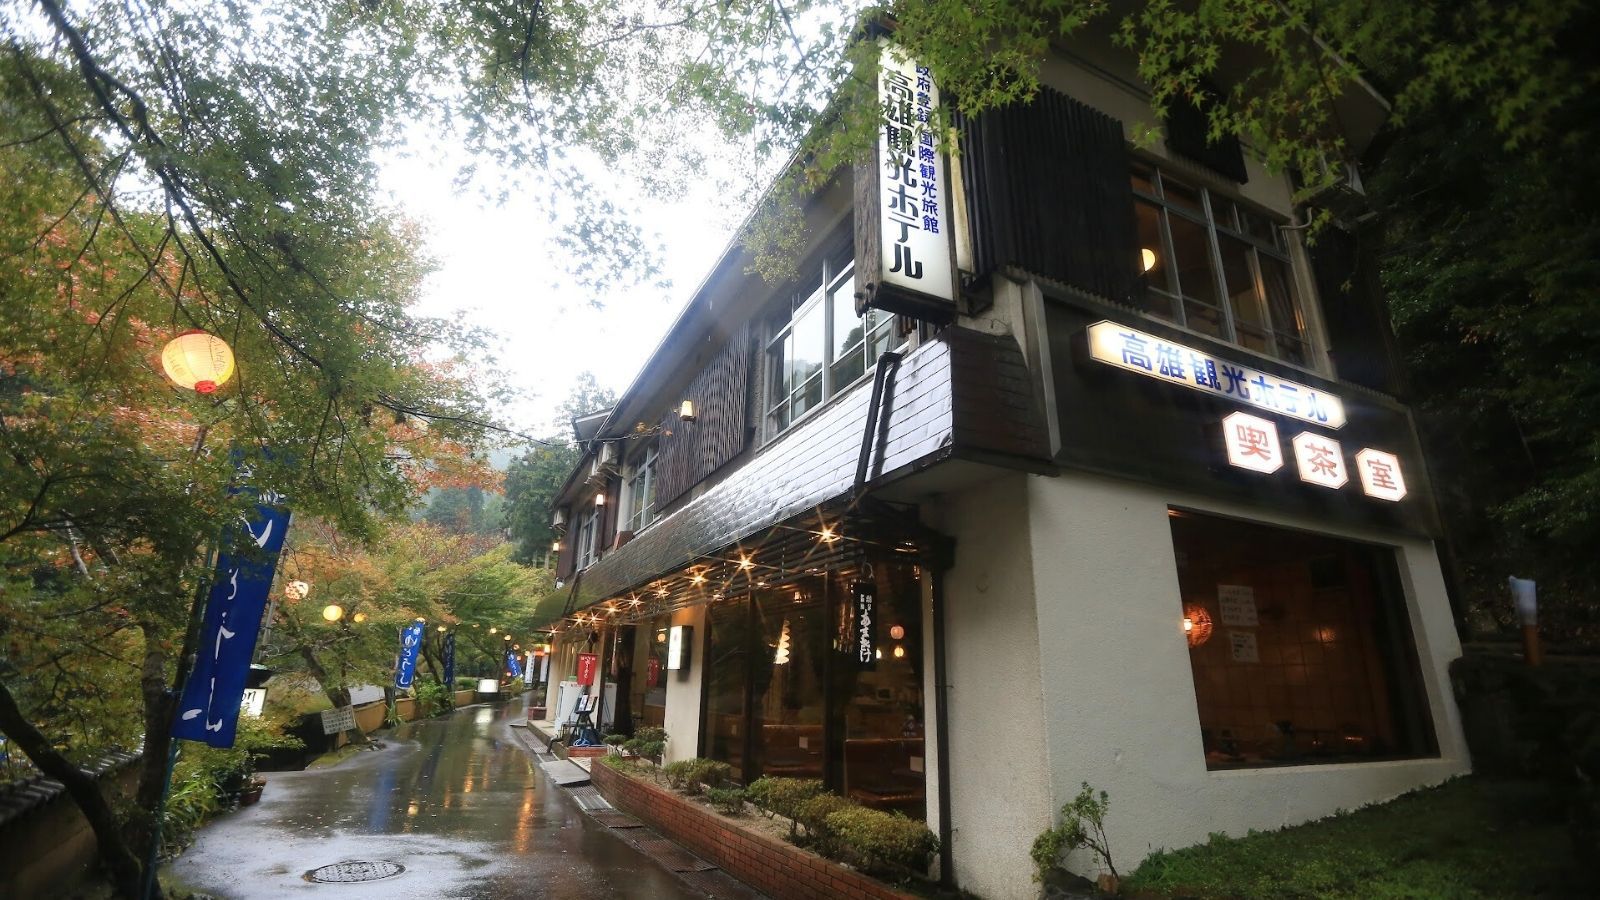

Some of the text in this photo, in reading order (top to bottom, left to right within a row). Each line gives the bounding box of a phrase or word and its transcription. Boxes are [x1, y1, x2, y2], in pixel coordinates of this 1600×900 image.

[1118, 331, 1328, 422] 高雄観光ホテル
[1236, 424, 1398, 491] 喫茶室
